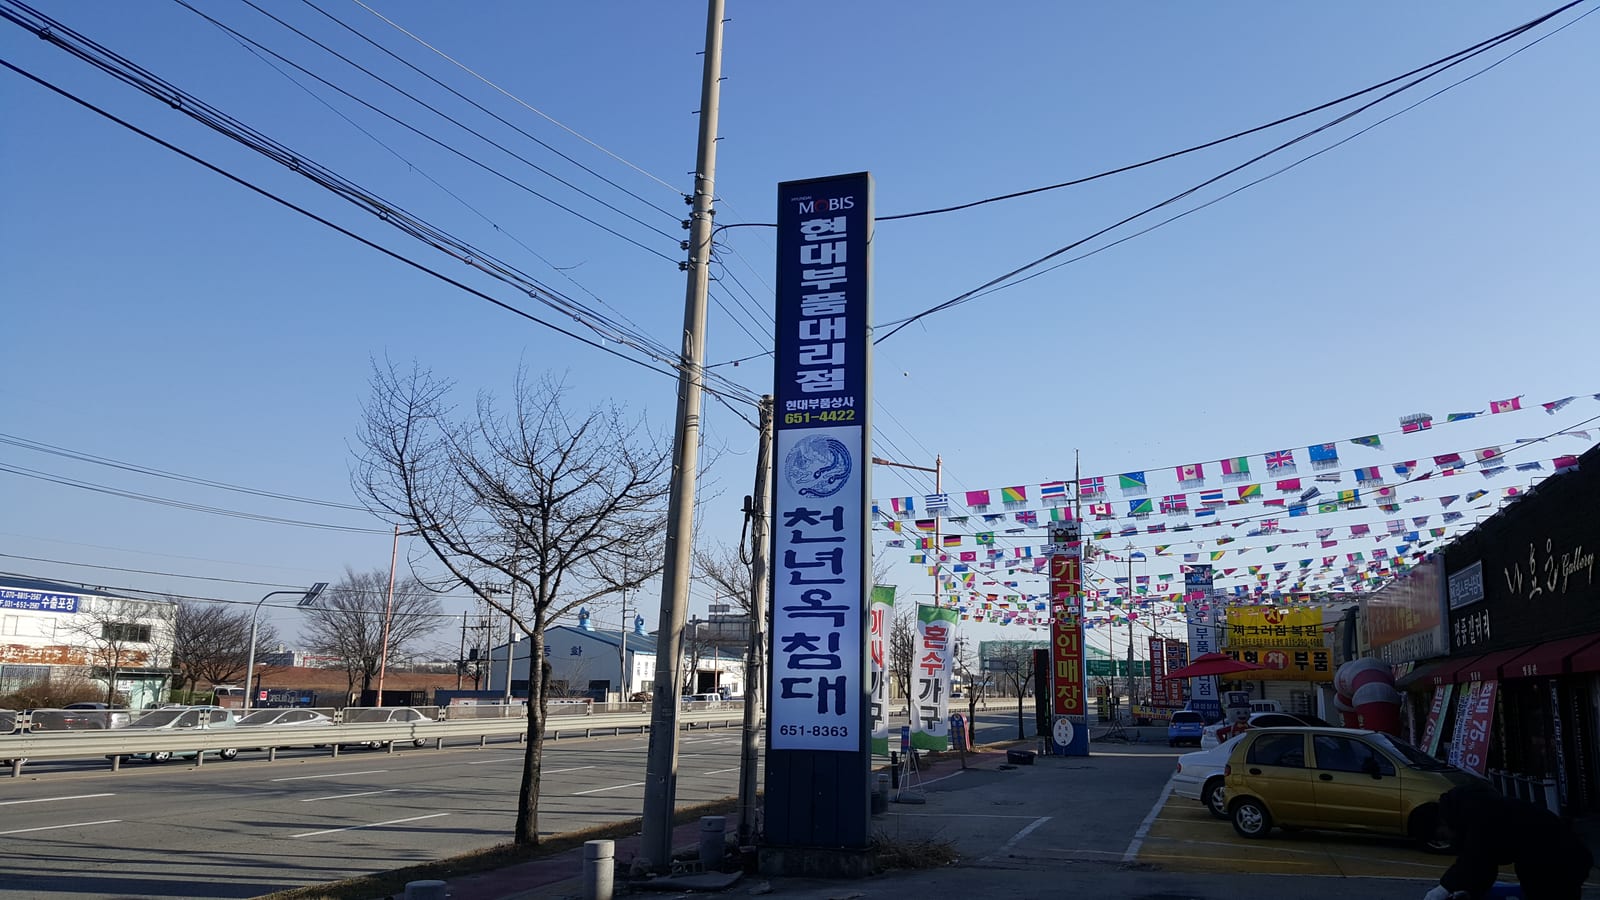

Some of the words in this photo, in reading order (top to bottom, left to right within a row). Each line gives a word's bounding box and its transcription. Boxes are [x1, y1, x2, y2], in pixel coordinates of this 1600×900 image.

[799, 196, 854, 215] MOBIS
[795, 215, 848, 393] 현대부품대리점
[785, 396, 855, 411] 현대부품상사
[784, 410, 856, 425] 651-4422
[41, 595, 75, 611] 수출포장
[780, 725, 848, 738] 651-8363
